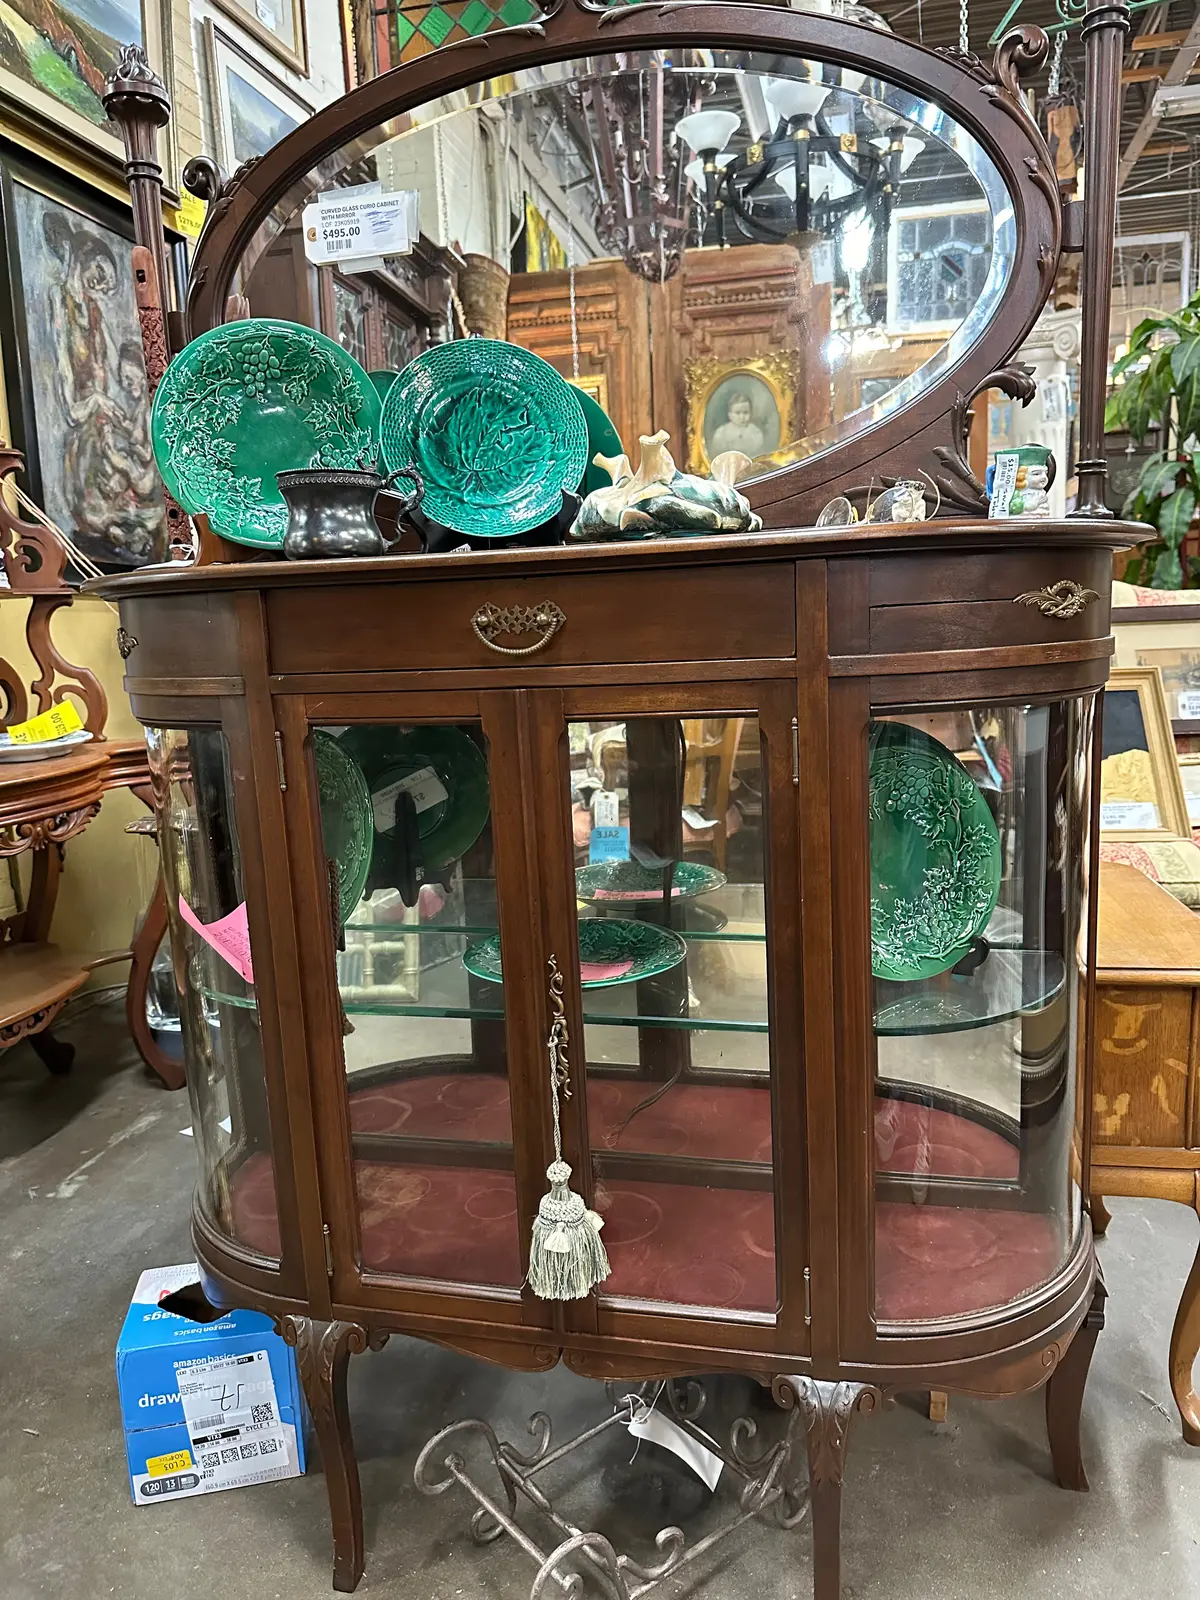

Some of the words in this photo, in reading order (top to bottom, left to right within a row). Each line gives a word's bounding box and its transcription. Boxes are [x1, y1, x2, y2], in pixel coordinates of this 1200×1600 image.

[321, 207, 341, 215] CURVED
[342, 205, 359, 213] GLASS
[377, 200, 399, 208] CABINET
[321, 214, 335, 222] WITH
[335, 211, 356, 220] MIRROR
[322, 226, 361, 240] $495.00
[1005, 458, 1014, 485] $15.00
[257, 1353, 263, 1361] C
[173, 1357, 207, 1369] amazon
[245, 1422, 264, 1432] CYCLE
[144, 1483, 160, 1493] 120
[165, 1480, 176, 1489] 13
